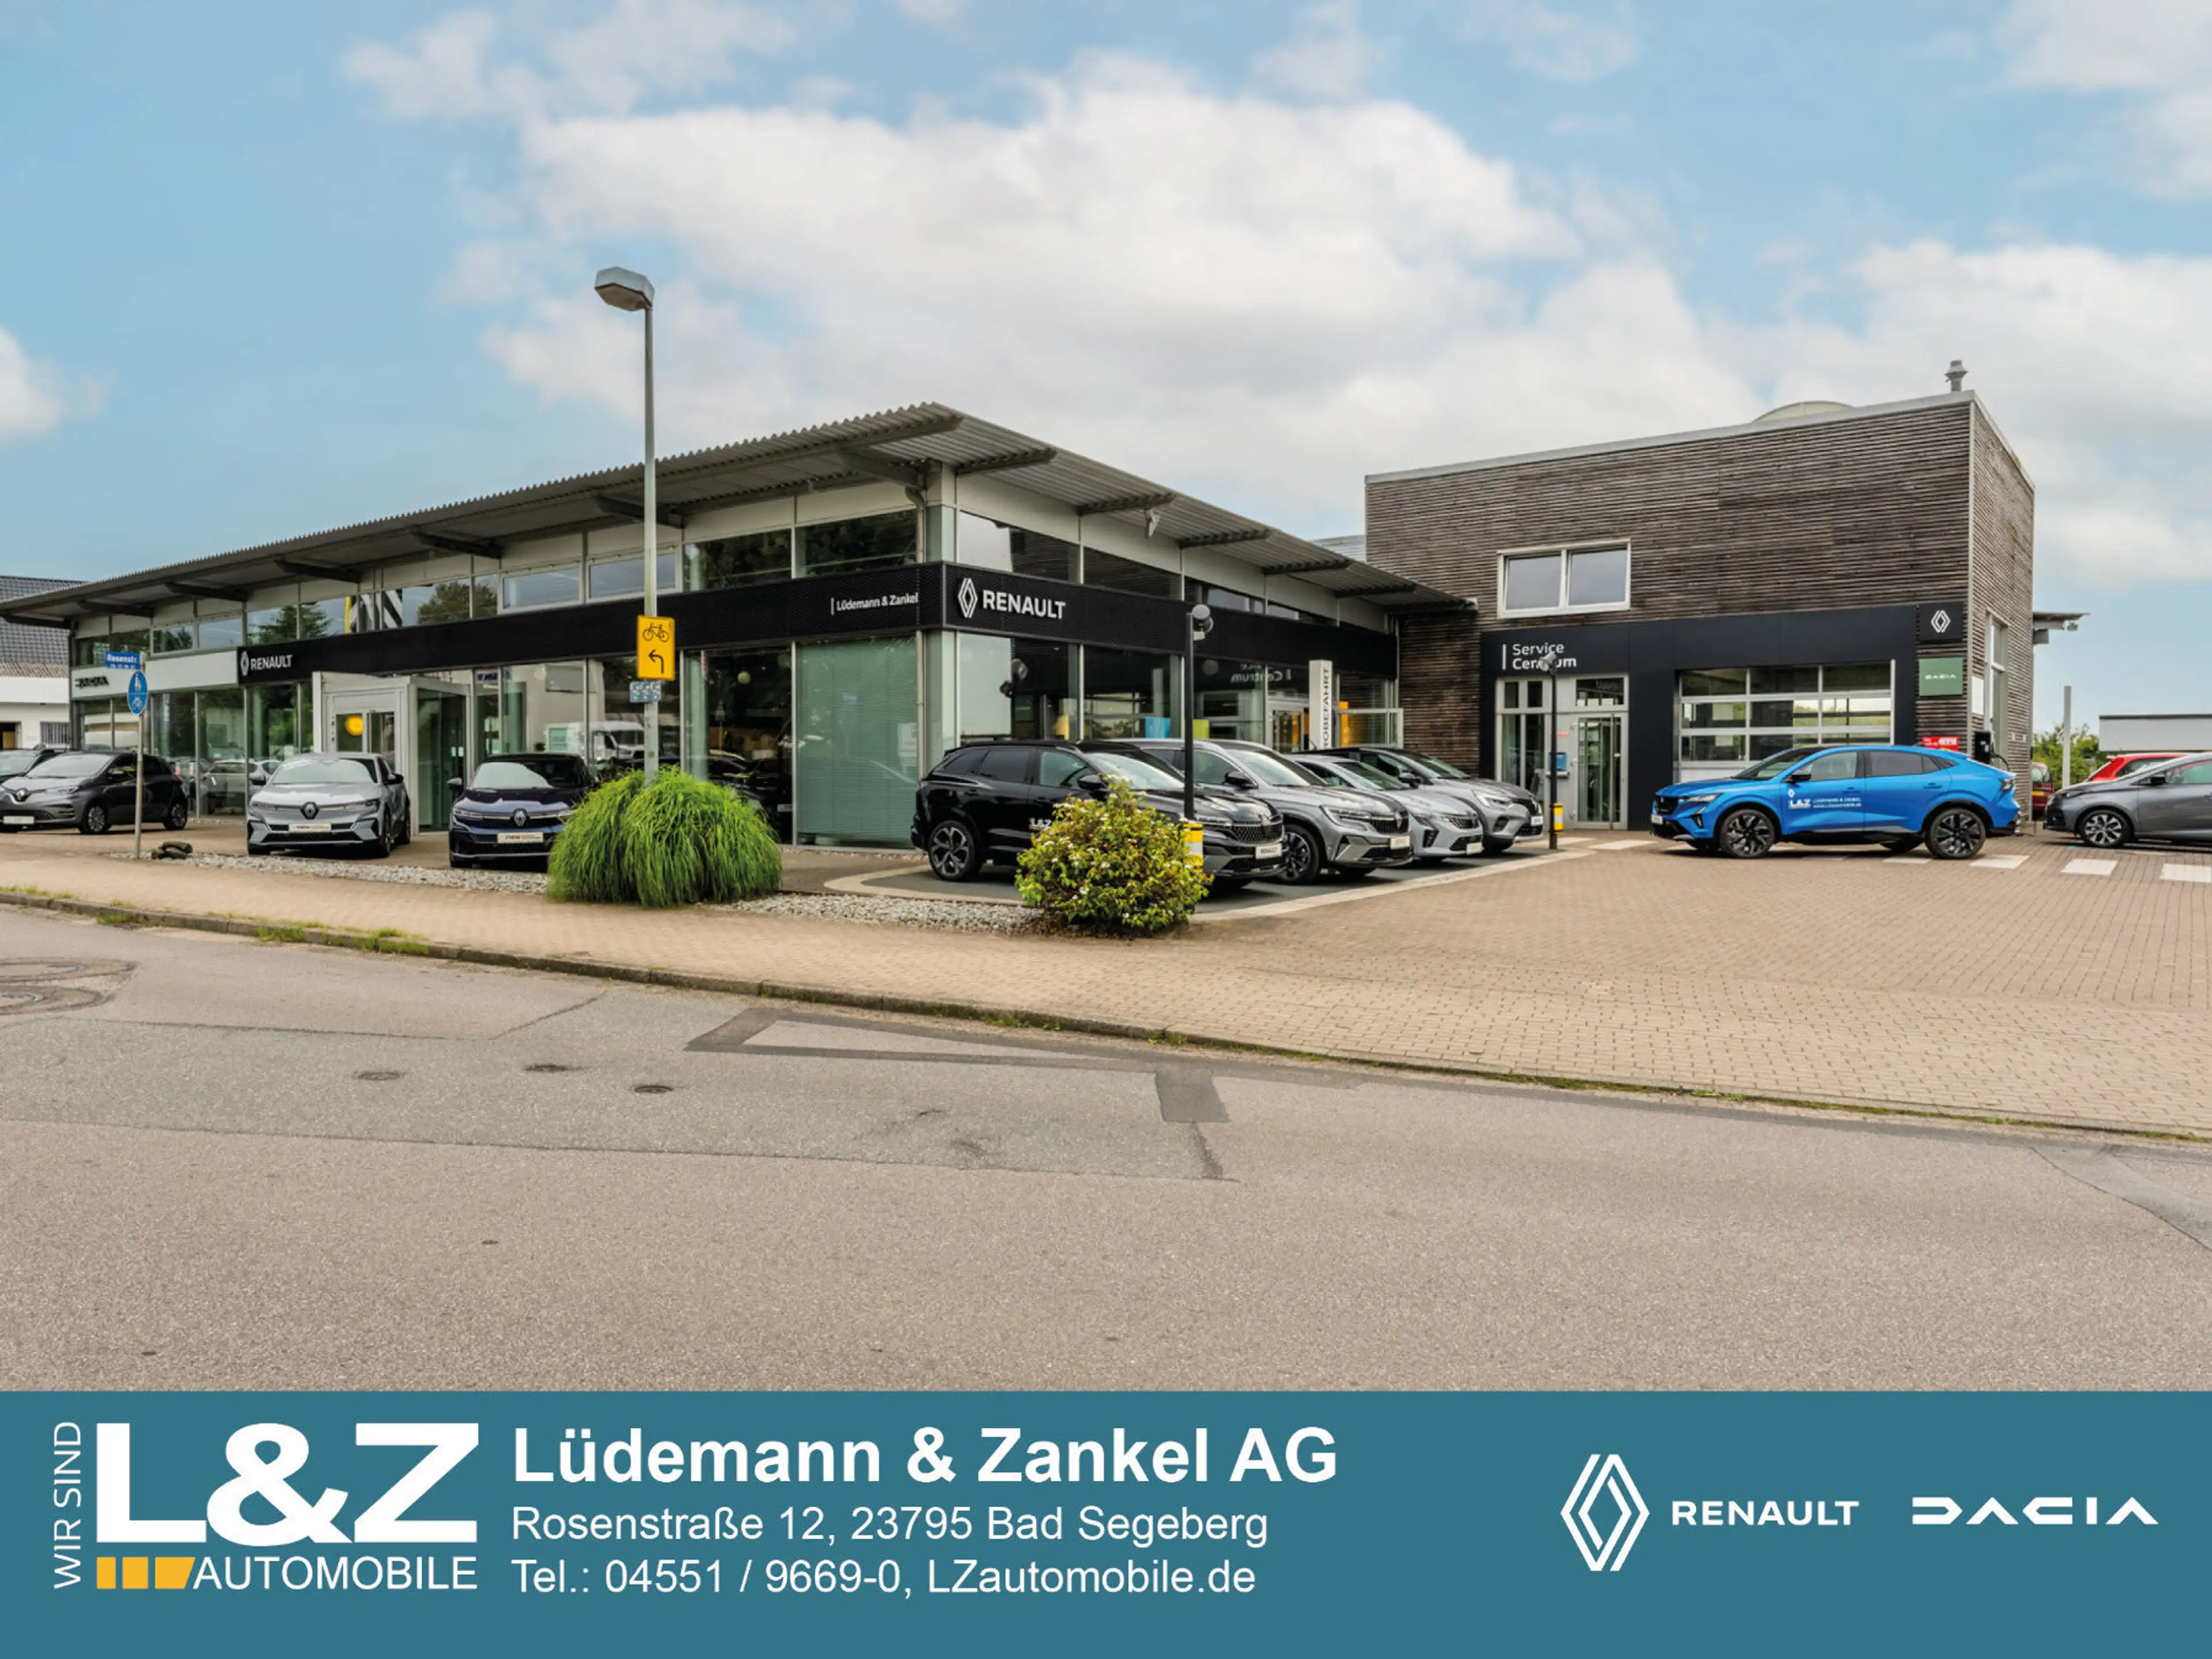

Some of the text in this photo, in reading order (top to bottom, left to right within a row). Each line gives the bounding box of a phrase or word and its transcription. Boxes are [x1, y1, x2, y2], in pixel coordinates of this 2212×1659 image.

[836, 592, 919, 612] Lüdemann & Zankel
[983, 589, 1066, 620] RENAULT
[1512, 642, 1565, 656] Service
[251, 654, 293, 671] RENAULT
[1512, 657, 1577, 670] Cenum
